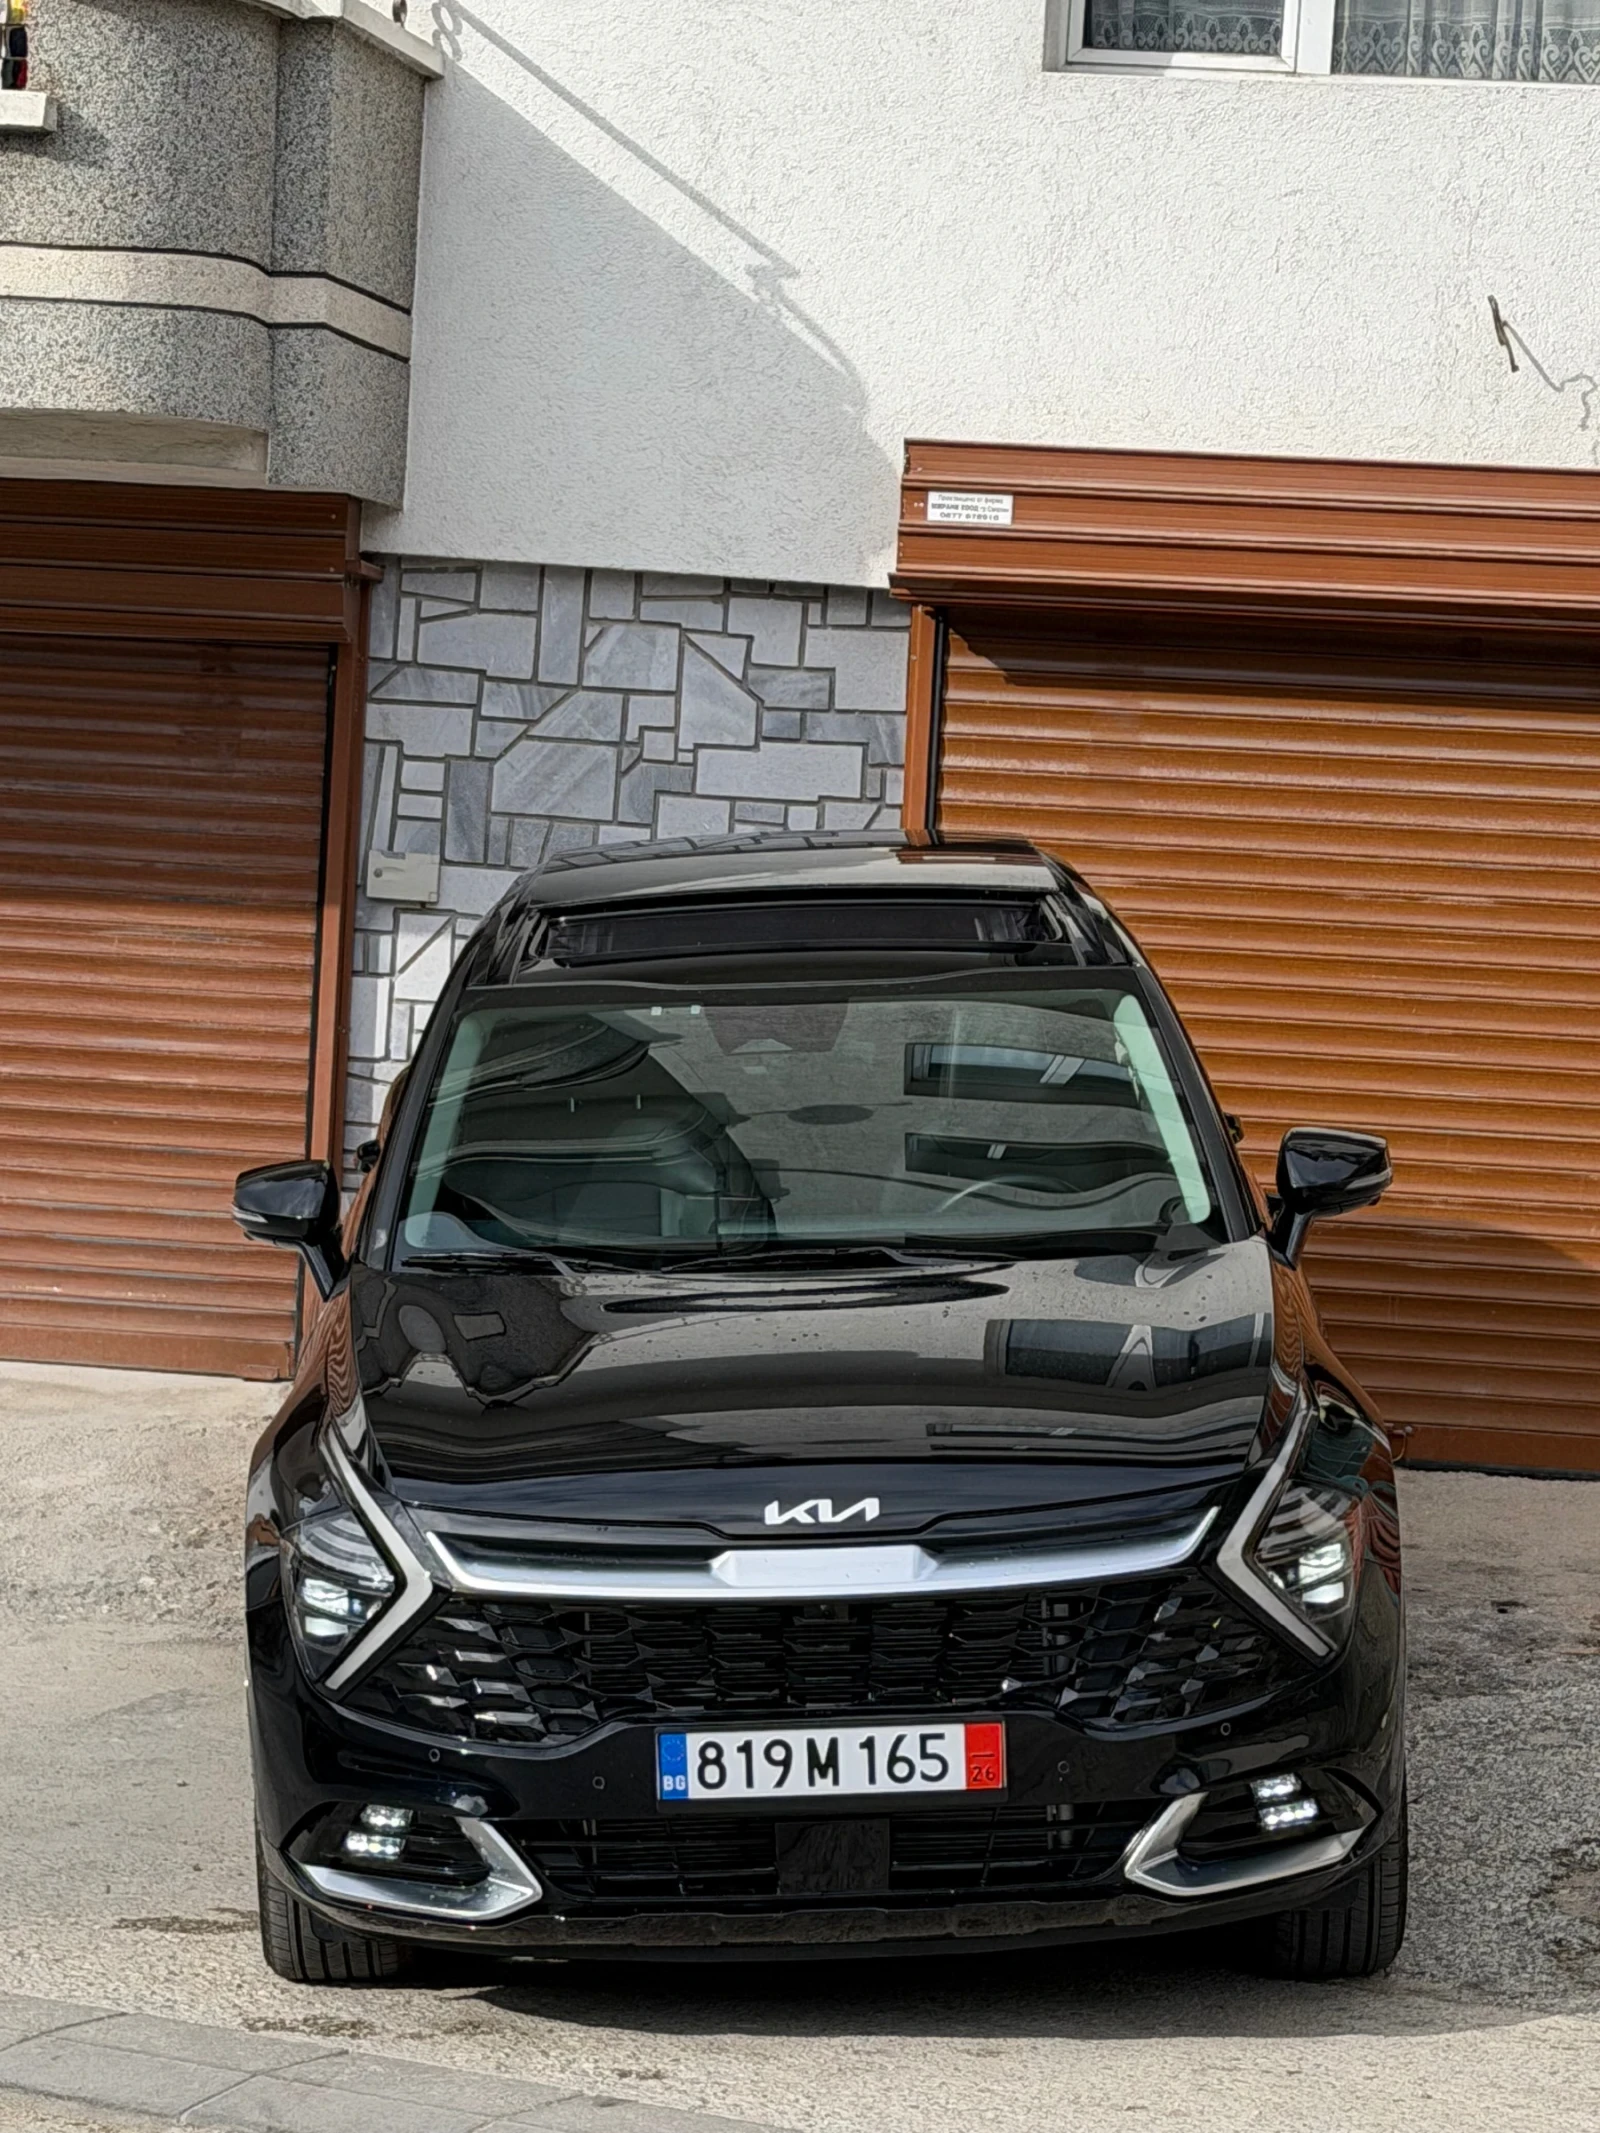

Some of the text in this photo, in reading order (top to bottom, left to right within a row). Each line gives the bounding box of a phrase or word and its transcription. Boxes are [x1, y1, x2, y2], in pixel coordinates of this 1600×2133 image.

[764, 1497, 880, 1525] KIA
[697, 1732, 950, 1790] 819 M 165
[662, 1775, 686, 1791] BG
[971, 1765, 996, 1782] 26
